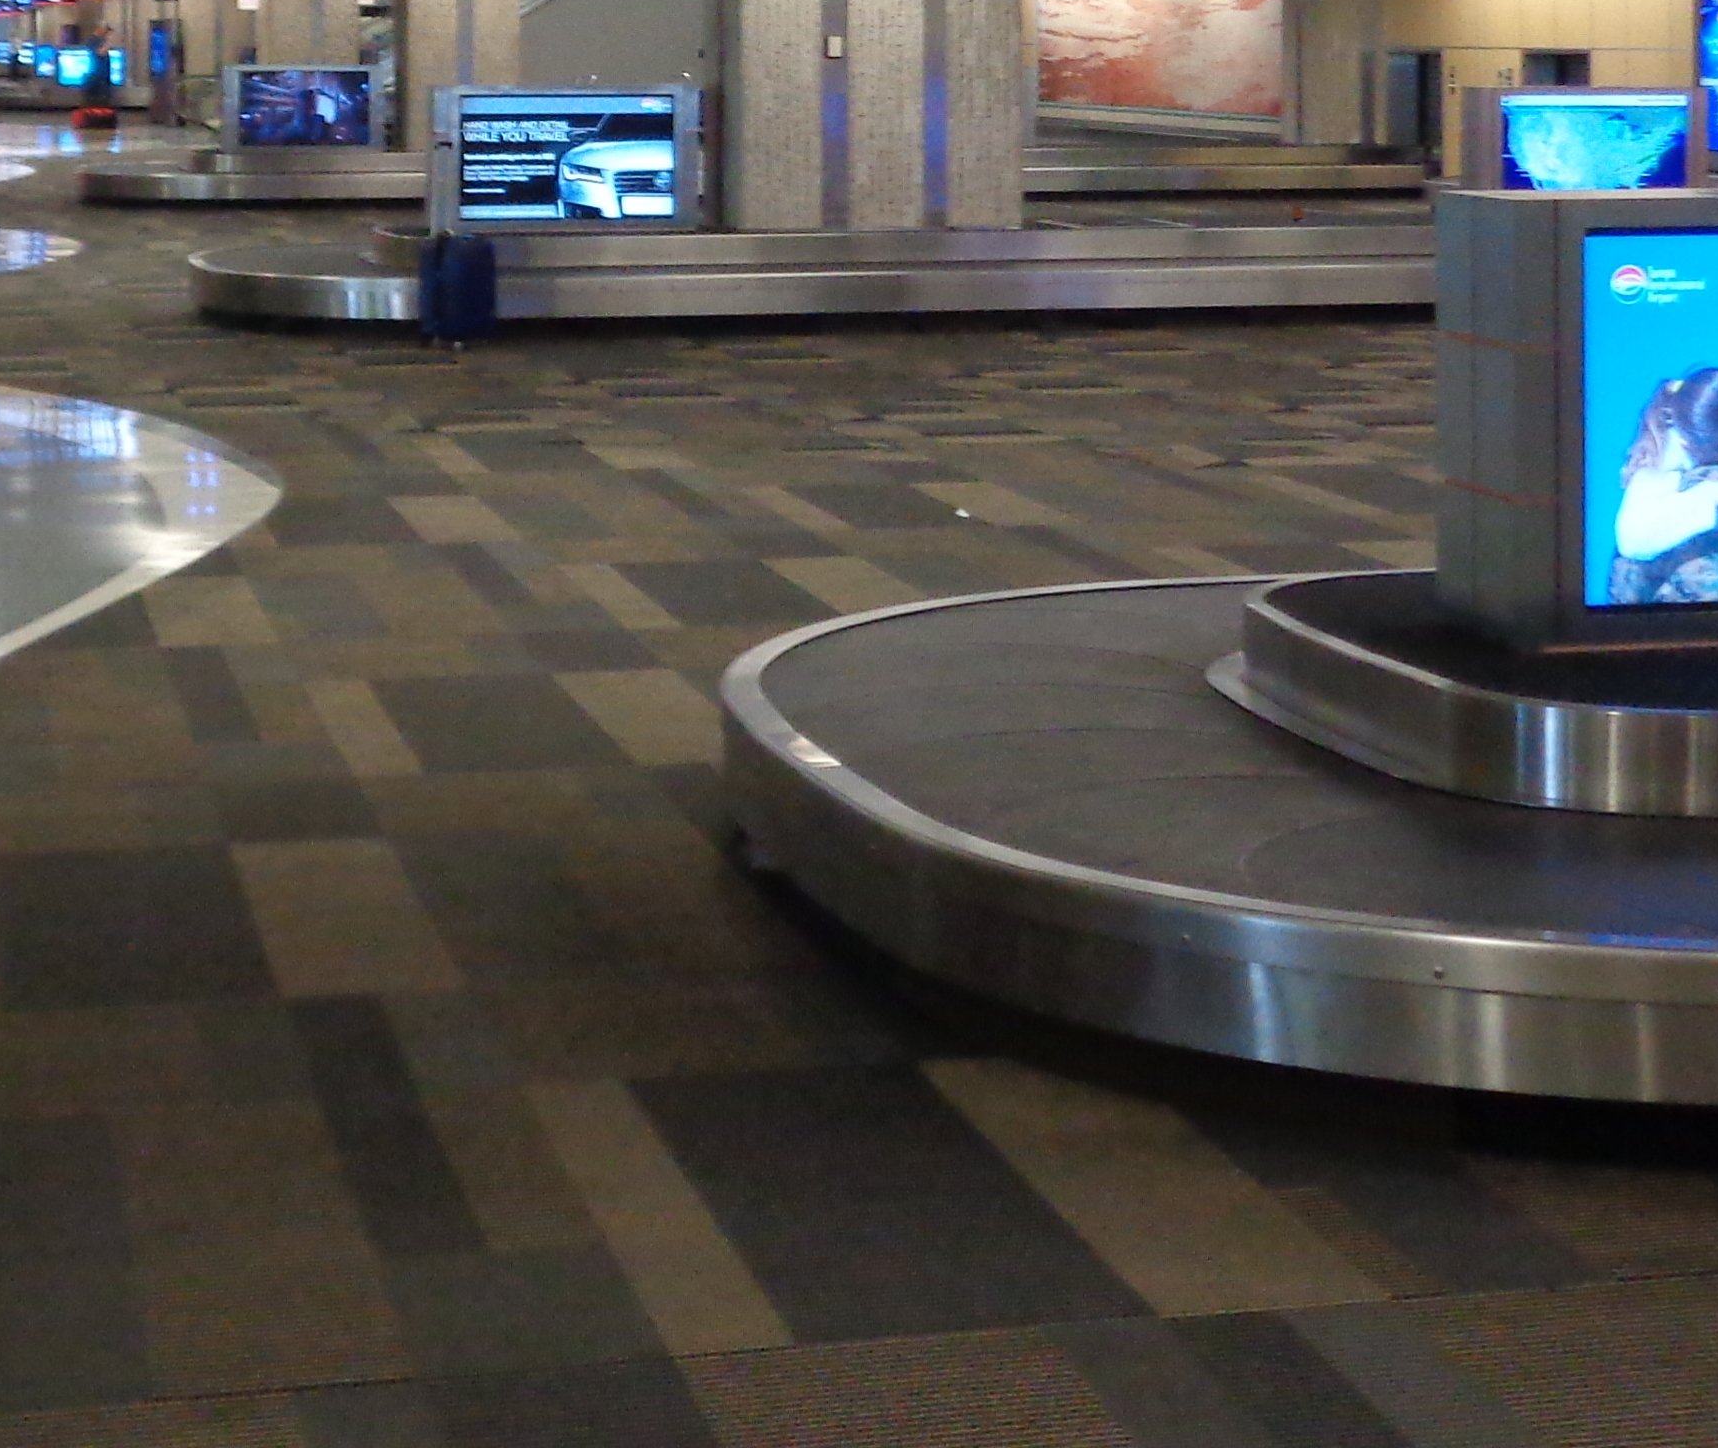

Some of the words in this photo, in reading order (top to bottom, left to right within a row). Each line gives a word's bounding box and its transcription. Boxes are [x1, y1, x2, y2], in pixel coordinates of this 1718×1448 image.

[463, 132, 501, 142] WHILE
[501, 132, 527, 142] YOU
[528, 132, 570, 142] TRAVEL
